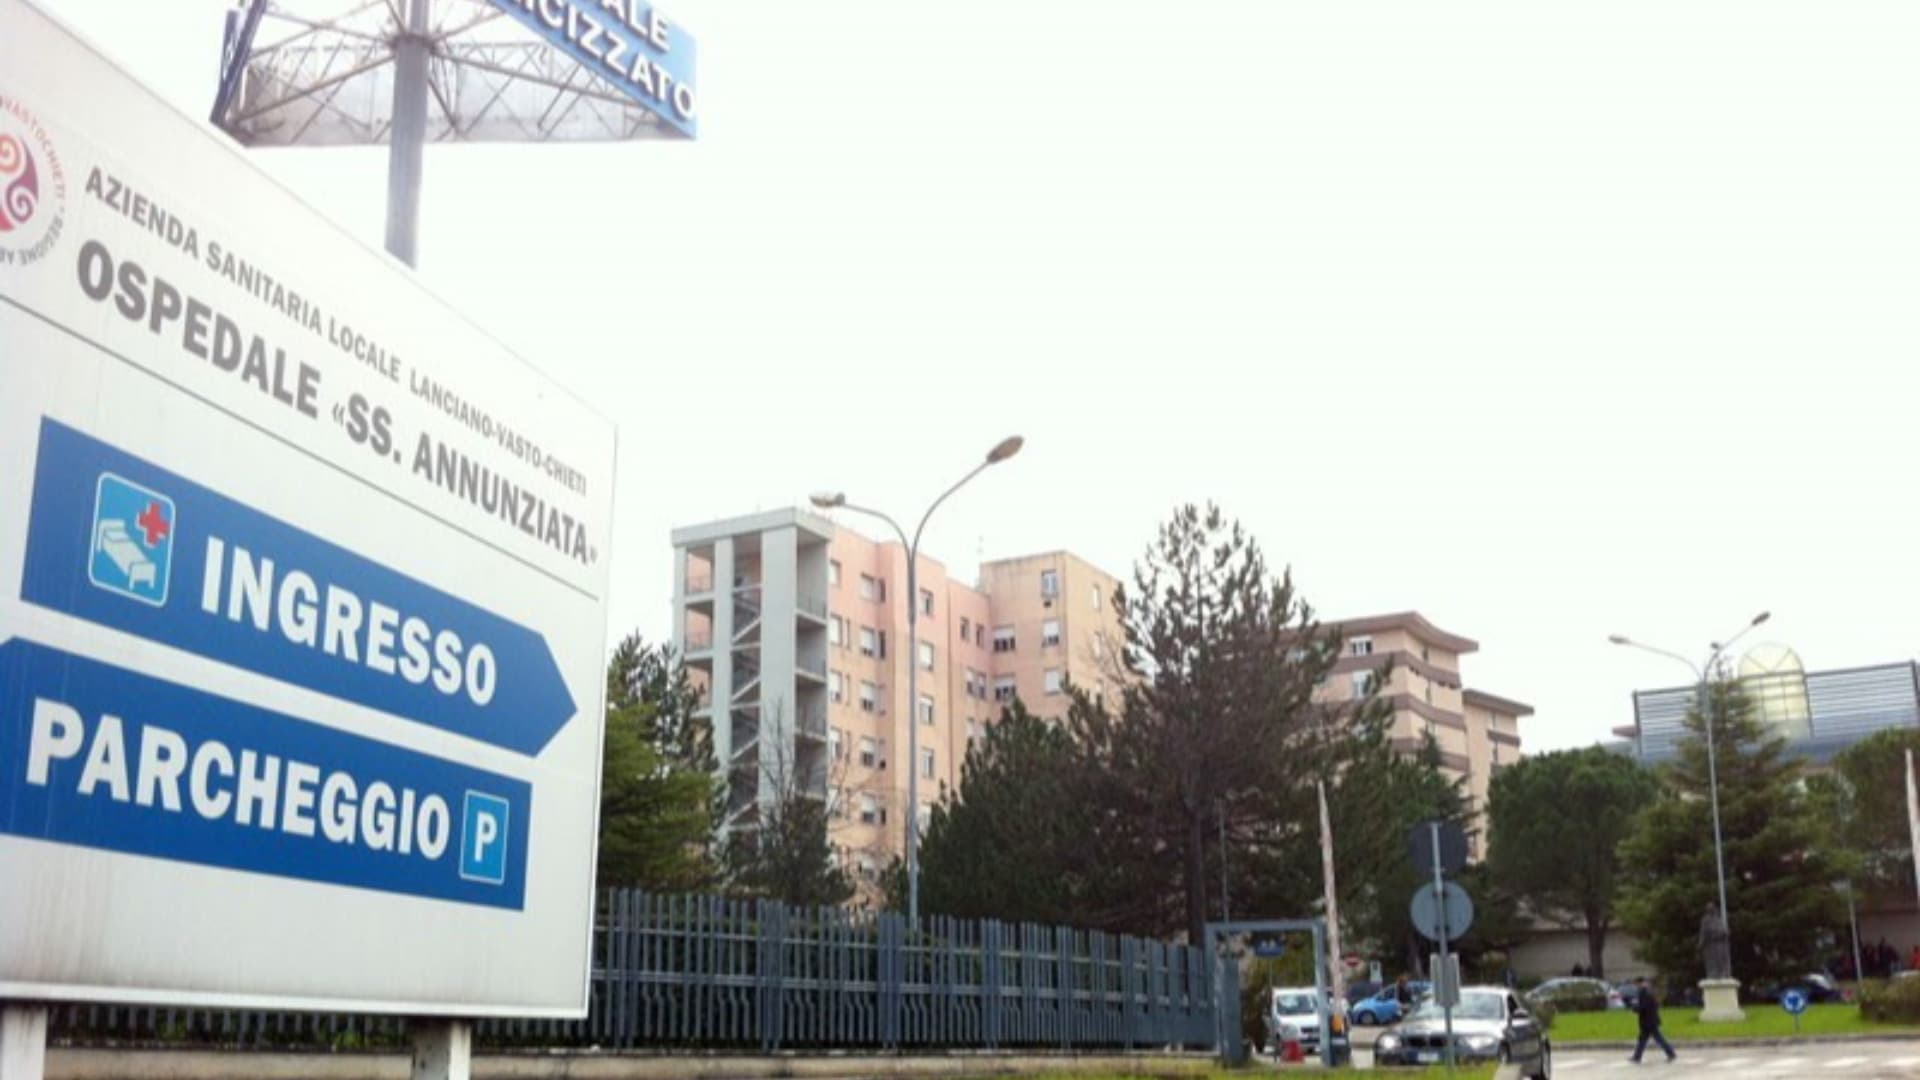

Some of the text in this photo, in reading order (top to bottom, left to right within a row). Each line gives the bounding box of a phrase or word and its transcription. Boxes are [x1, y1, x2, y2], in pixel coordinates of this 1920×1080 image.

[77, 239, 321, 419] OSPEDALE
[85, 165, 587, 497] AZIENDA SANITARIA LOCALE LANCIANO-VASTO-CHIETI
[202, 536, 496, 706] INGRESSO
[26, 697, 497, 862] PARCHEGGIO P
